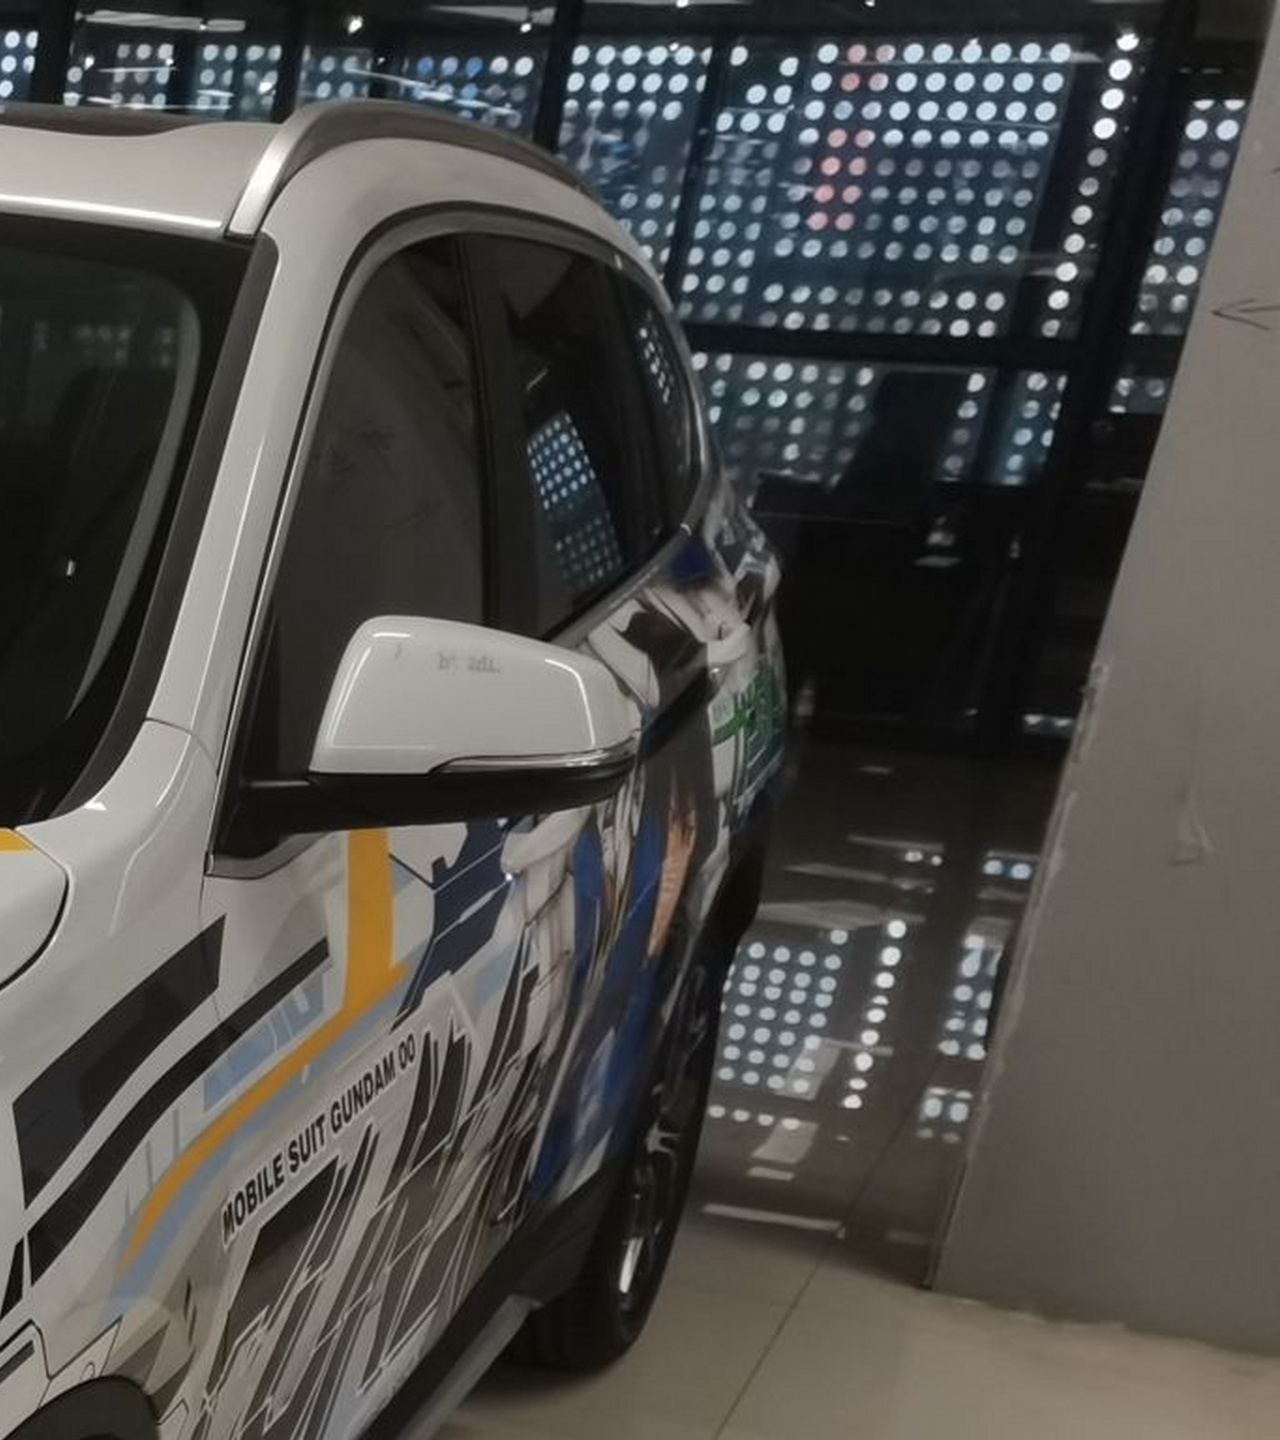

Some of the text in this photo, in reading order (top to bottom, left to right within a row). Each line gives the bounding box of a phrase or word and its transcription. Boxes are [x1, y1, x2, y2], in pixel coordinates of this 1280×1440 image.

[222, 1154, 285, 1243] MOBILE
[288, 1114, 326, 1173] SUIT
[330, 1050, 397, 1134] GUNDAM
